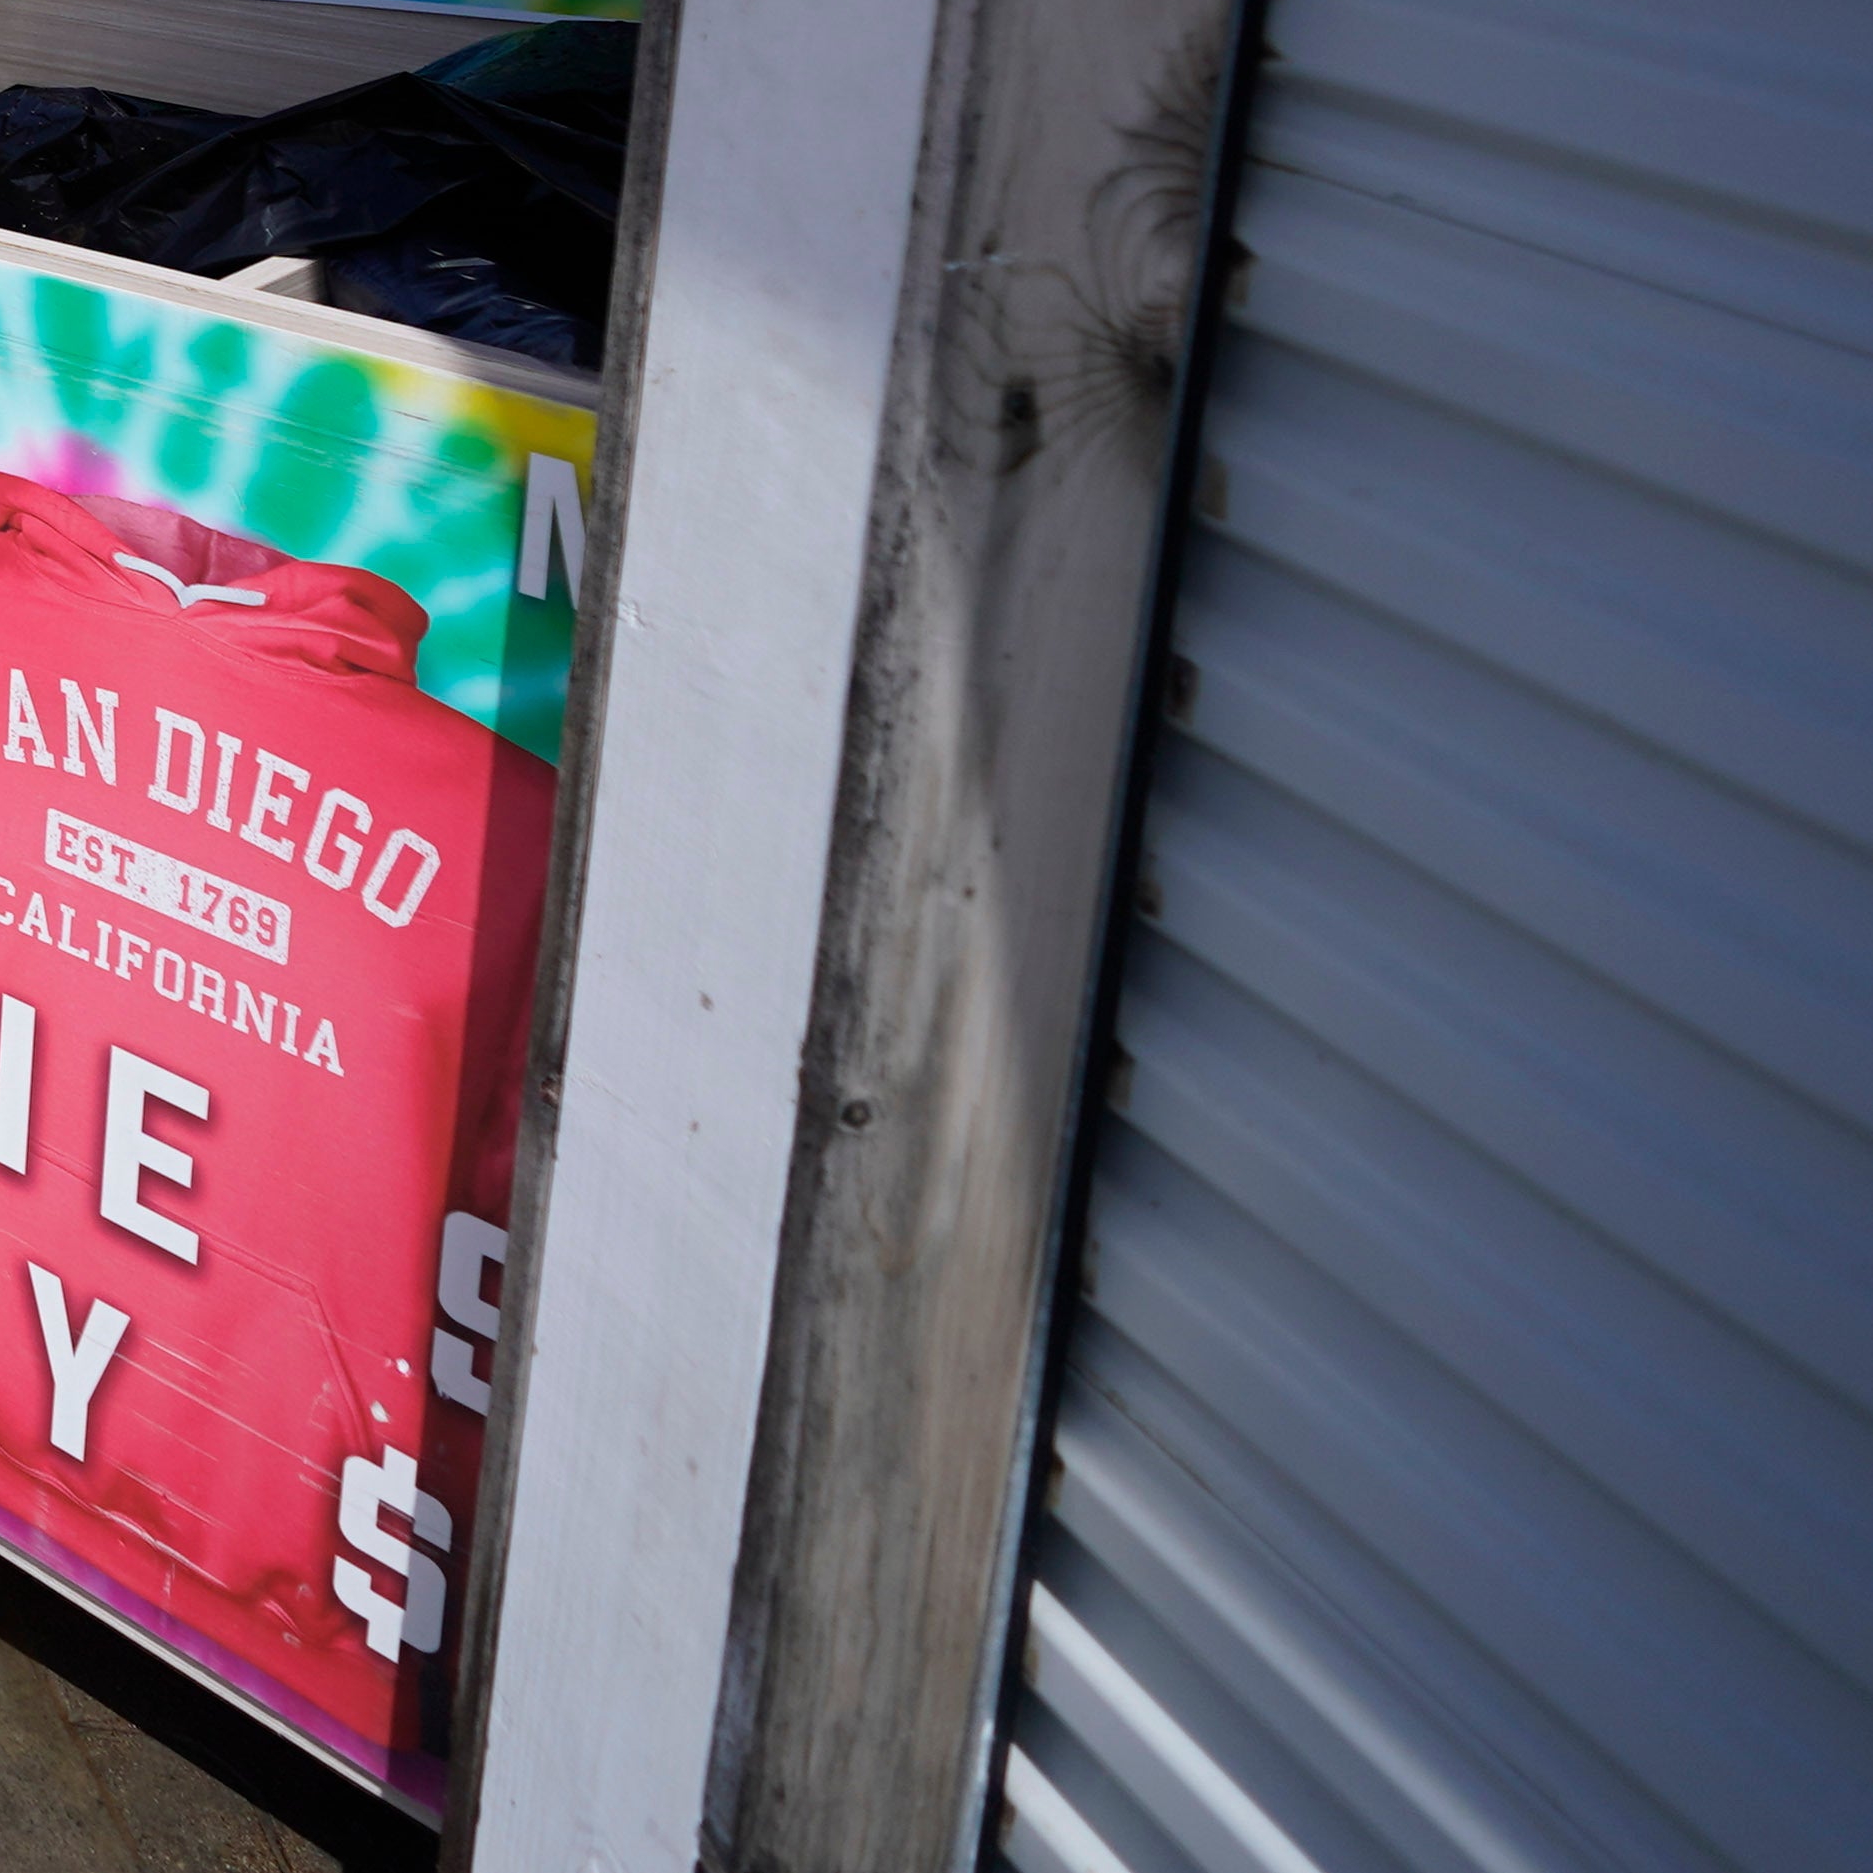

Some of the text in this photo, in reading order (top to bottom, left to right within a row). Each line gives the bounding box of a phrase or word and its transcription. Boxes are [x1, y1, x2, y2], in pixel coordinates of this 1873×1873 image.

[56, 821, 278, 947] EST. 1769
[147, 705, 441, 929] DIEGO
